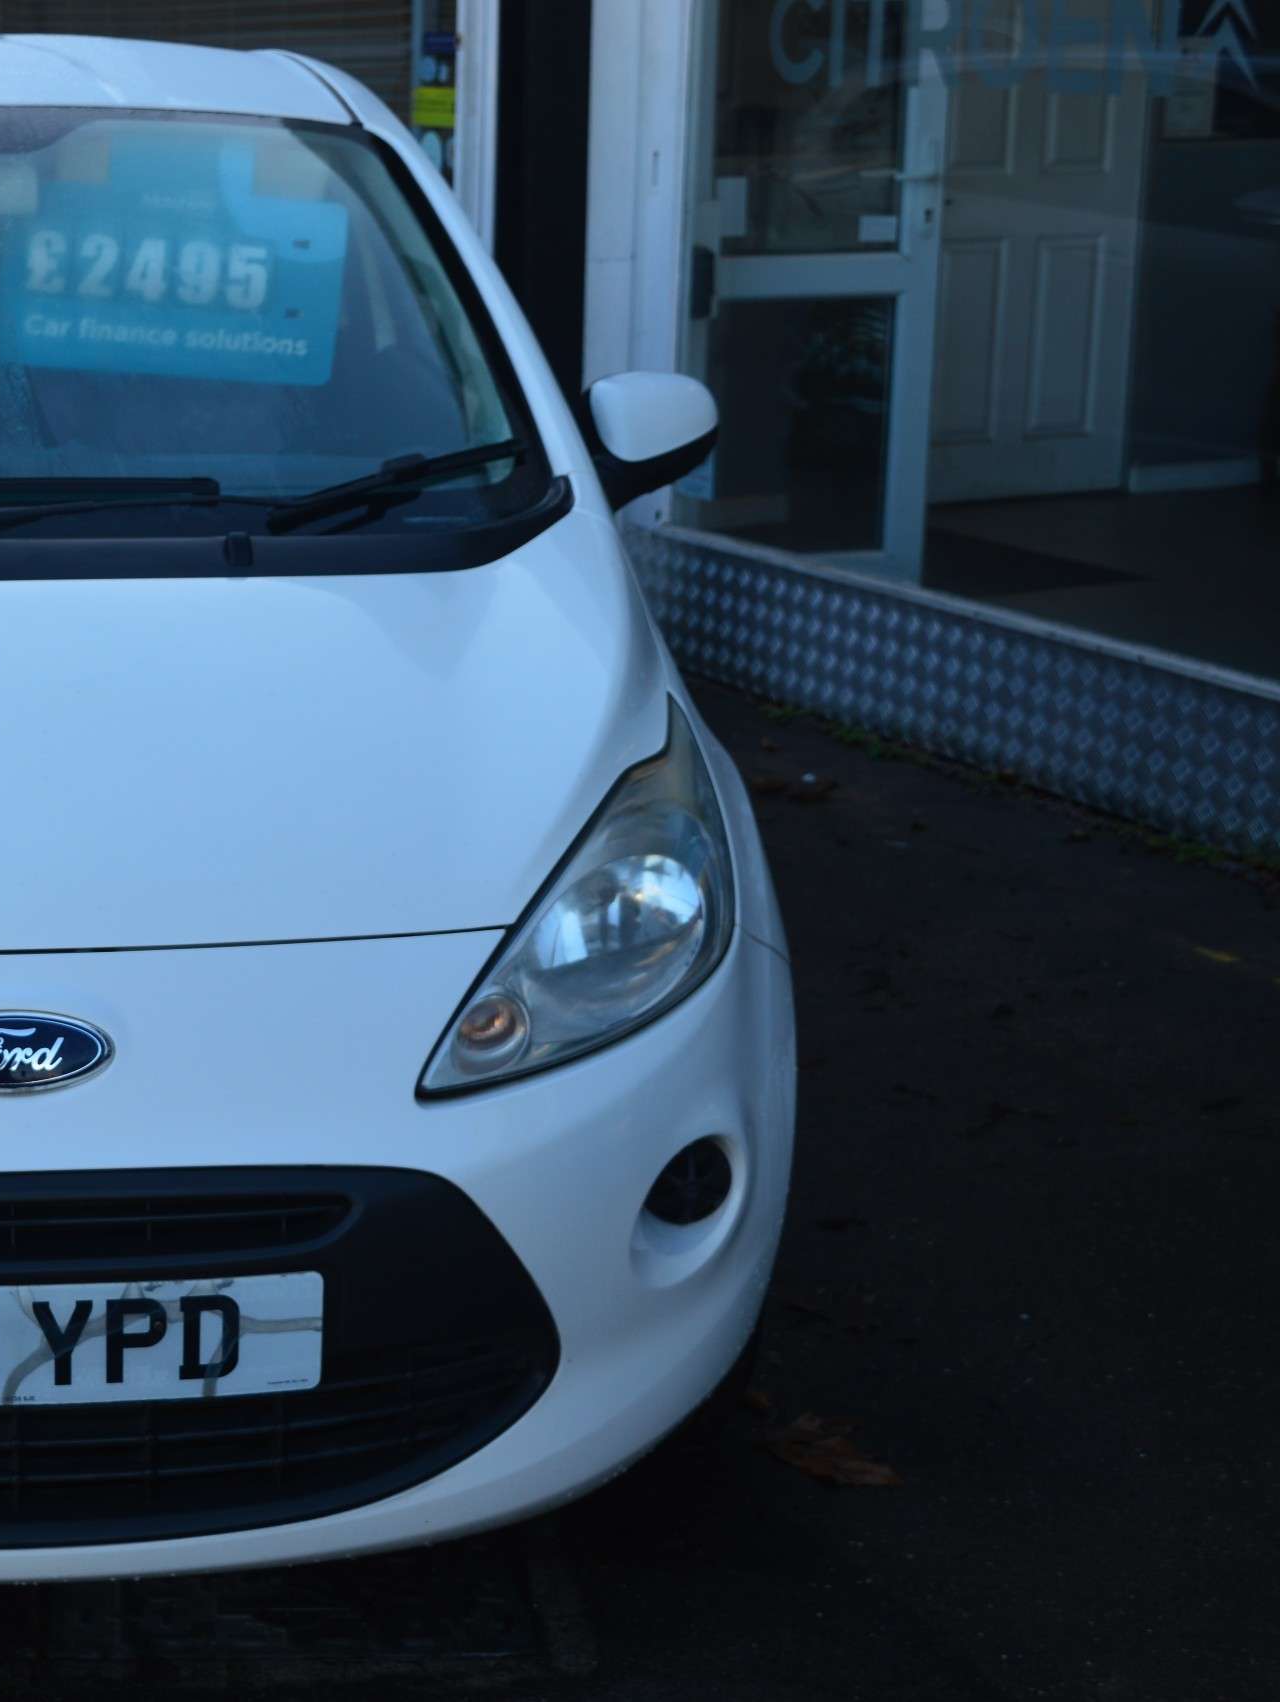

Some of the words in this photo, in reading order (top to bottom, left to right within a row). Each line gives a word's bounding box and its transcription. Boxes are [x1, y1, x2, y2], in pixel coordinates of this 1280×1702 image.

[25, 230, 269, 310] £2495
[24, 314, 72, 337] Car
[79, 317, 177, 346] finance
[186, 329, 309, 357] solutions
[33, 1295, 241, 1386] YPD
